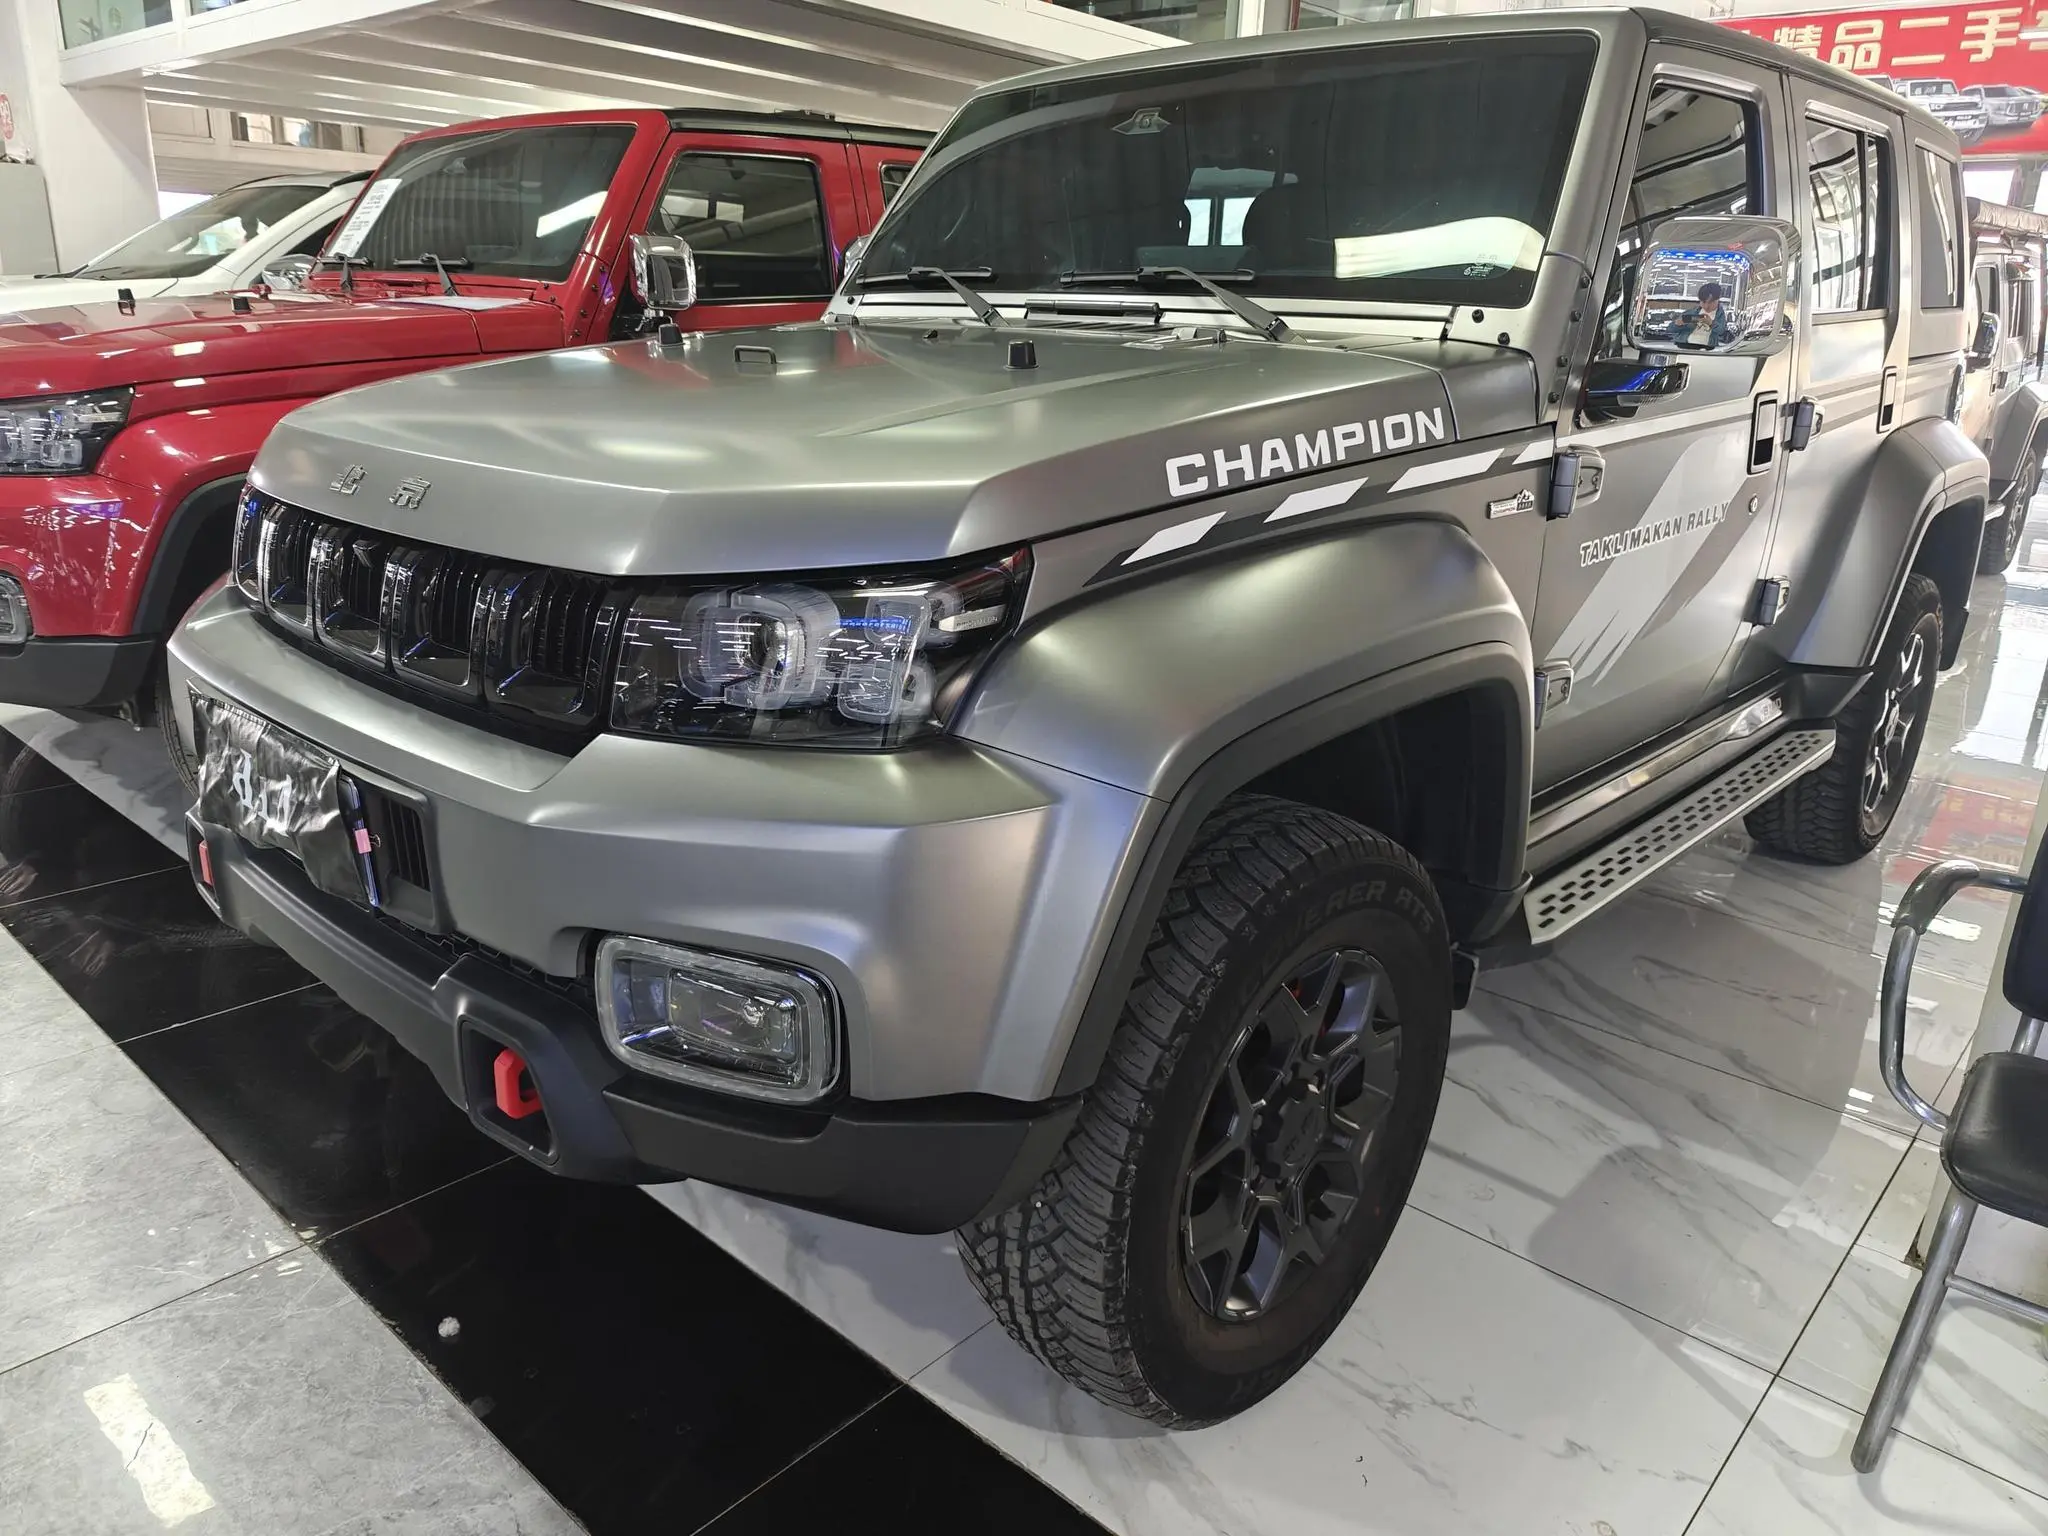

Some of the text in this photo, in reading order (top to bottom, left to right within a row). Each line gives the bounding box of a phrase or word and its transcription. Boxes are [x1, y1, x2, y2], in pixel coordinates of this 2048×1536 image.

[1741, 7, 2048, 71] 精品二手
[1166, 407, 1445, 498] CHAMPION
[1579, 500, 1732, 568] TAKLIMAKAN RALLY
